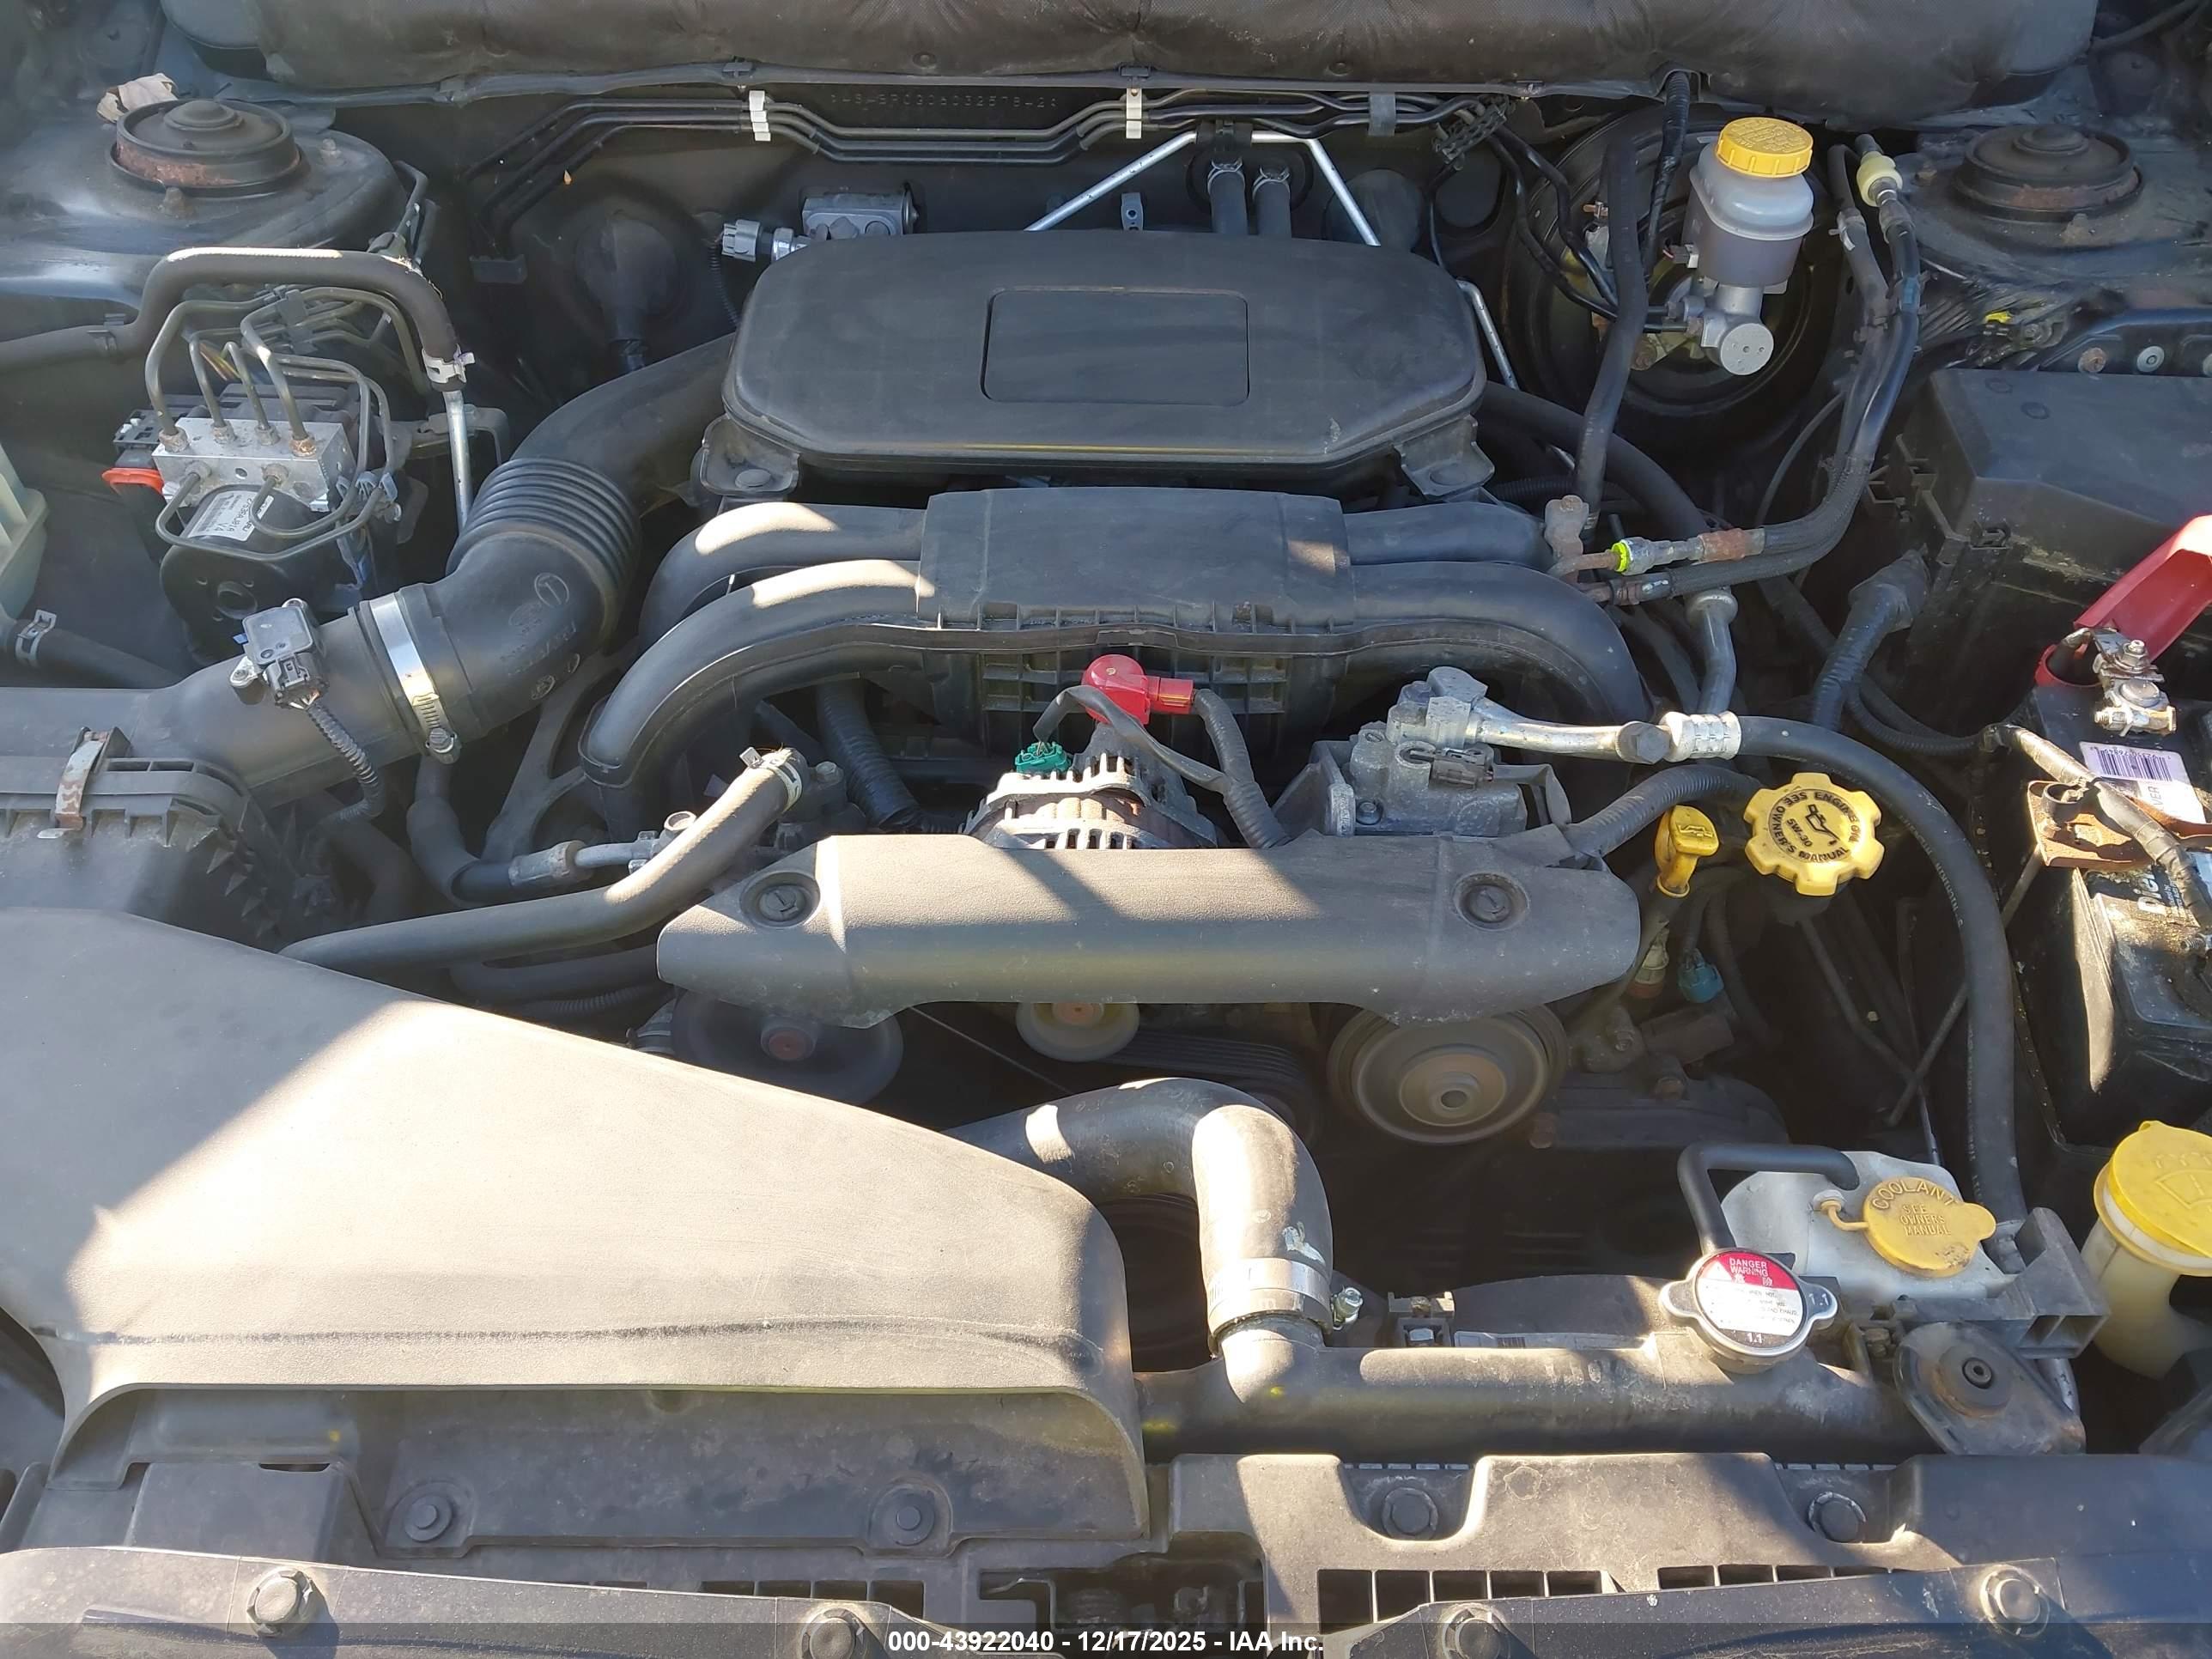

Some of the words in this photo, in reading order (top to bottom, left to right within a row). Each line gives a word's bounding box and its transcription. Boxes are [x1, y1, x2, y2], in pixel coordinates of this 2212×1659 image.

[1784, 791, 1808, 807] SEE
[1814, 792, 1859, 823] ENGINE
[1848, 824, 1861, 844] OIL
[1771, 805, 1796, 854] OWNER'S
[1786, 817, 1813, 848] 5W-30
[1798, 846, 1850, 863] MANUAL
[1872, 1179, 1955, 1210] COOLANT
[1903, 1204, 1927, 1214] SEE
[1905, 1224, 1951, 1236] MANUAL
[1729, 1257, 1767, 1269] DANGER
[1729, 1265, 1769, 1277] WARNING
[1747, 1332, 1763, 1344] 1.1
